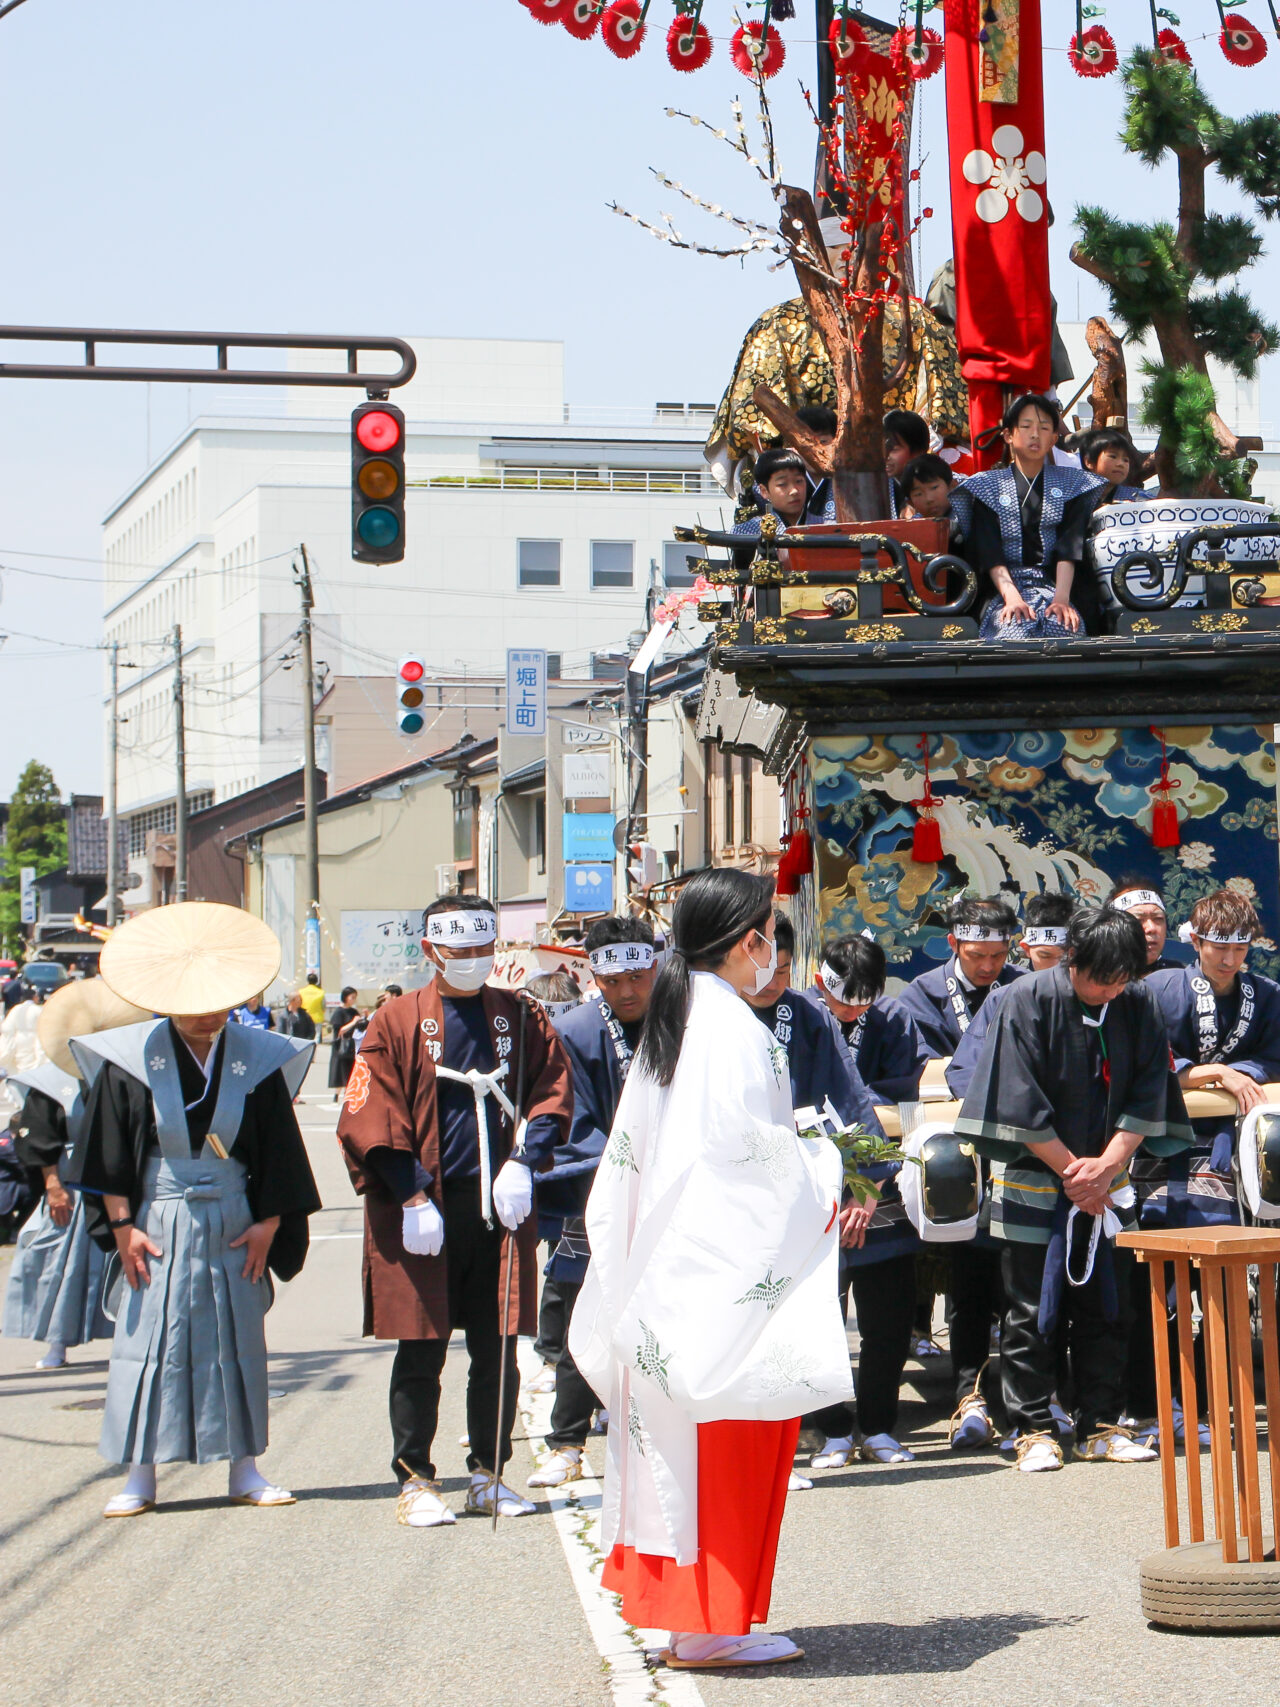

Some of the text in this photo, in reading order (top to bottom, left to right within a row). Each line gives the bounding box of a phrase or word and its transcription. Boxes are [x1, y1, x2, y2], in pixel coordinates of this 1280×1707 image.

[516, 667, 537, 727] 堀上町
[371, 942, 427, 958] ひづめ
